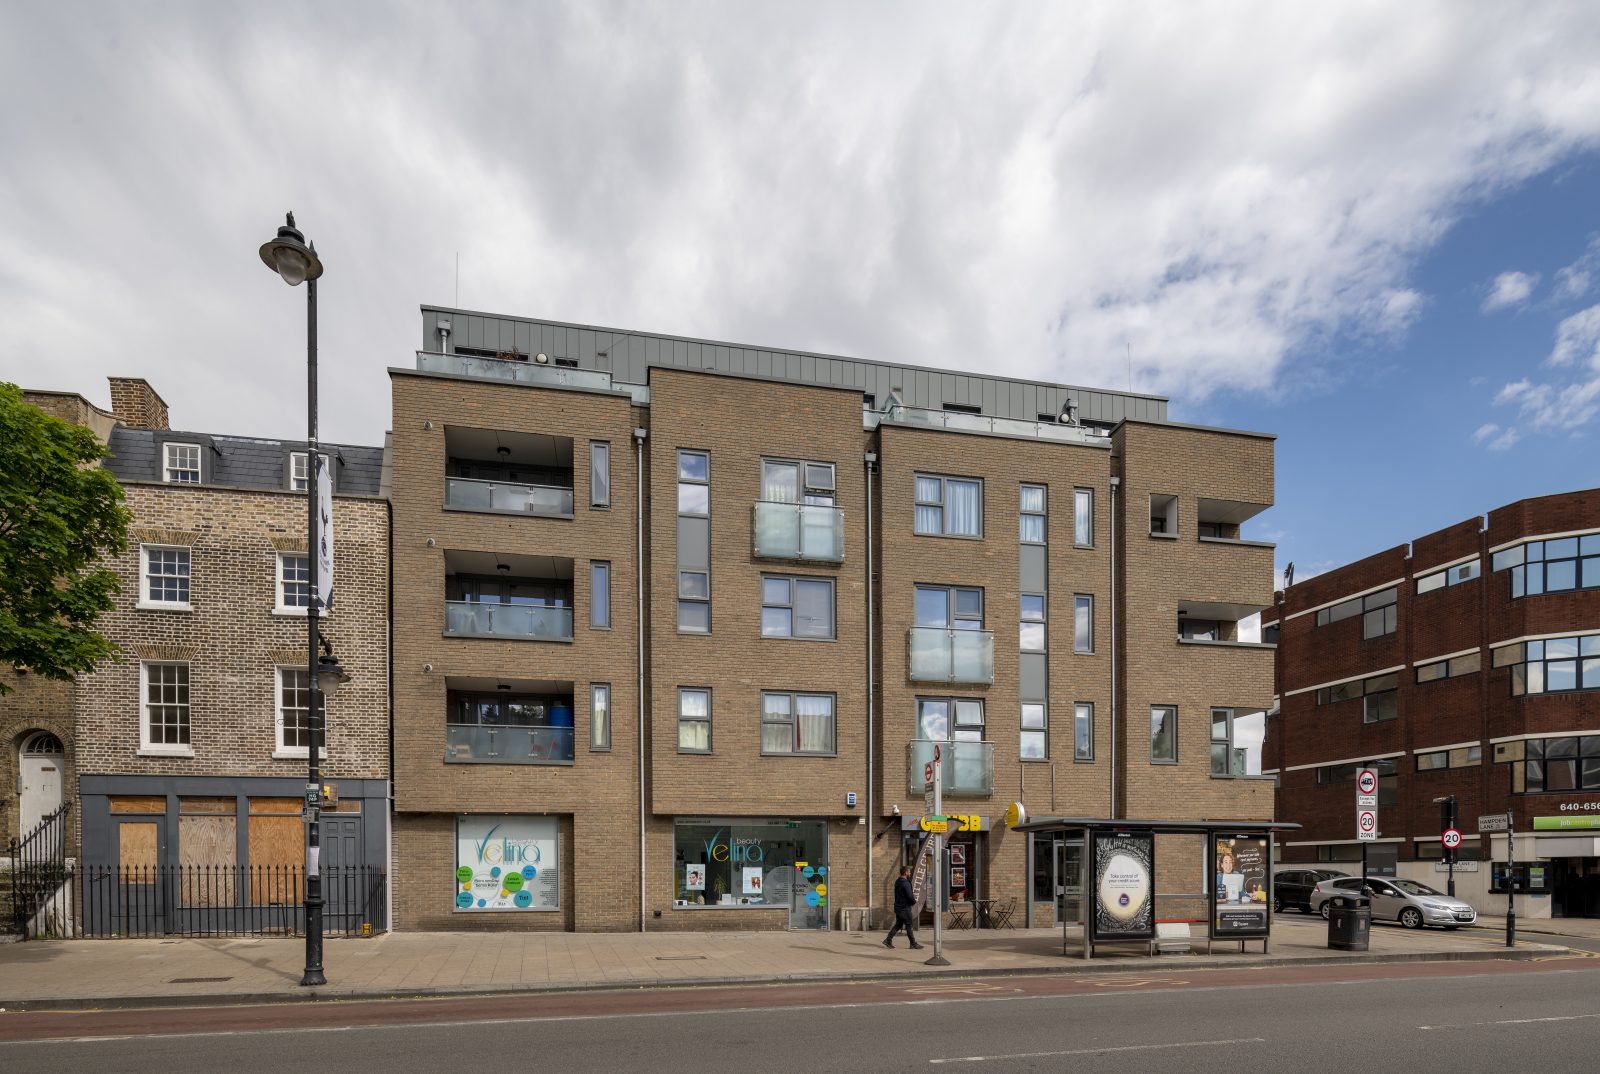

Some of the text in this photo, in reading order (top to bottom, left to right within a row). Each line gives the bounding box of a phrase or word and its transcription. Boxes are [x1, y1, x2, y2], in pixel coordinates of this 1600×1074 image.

[1362, 817, 1373, 826] 20
[474, 824, 541, 863] Velina
[703, 826, 763, 862] Velina
[1445, 834, 1459, 843] 20
